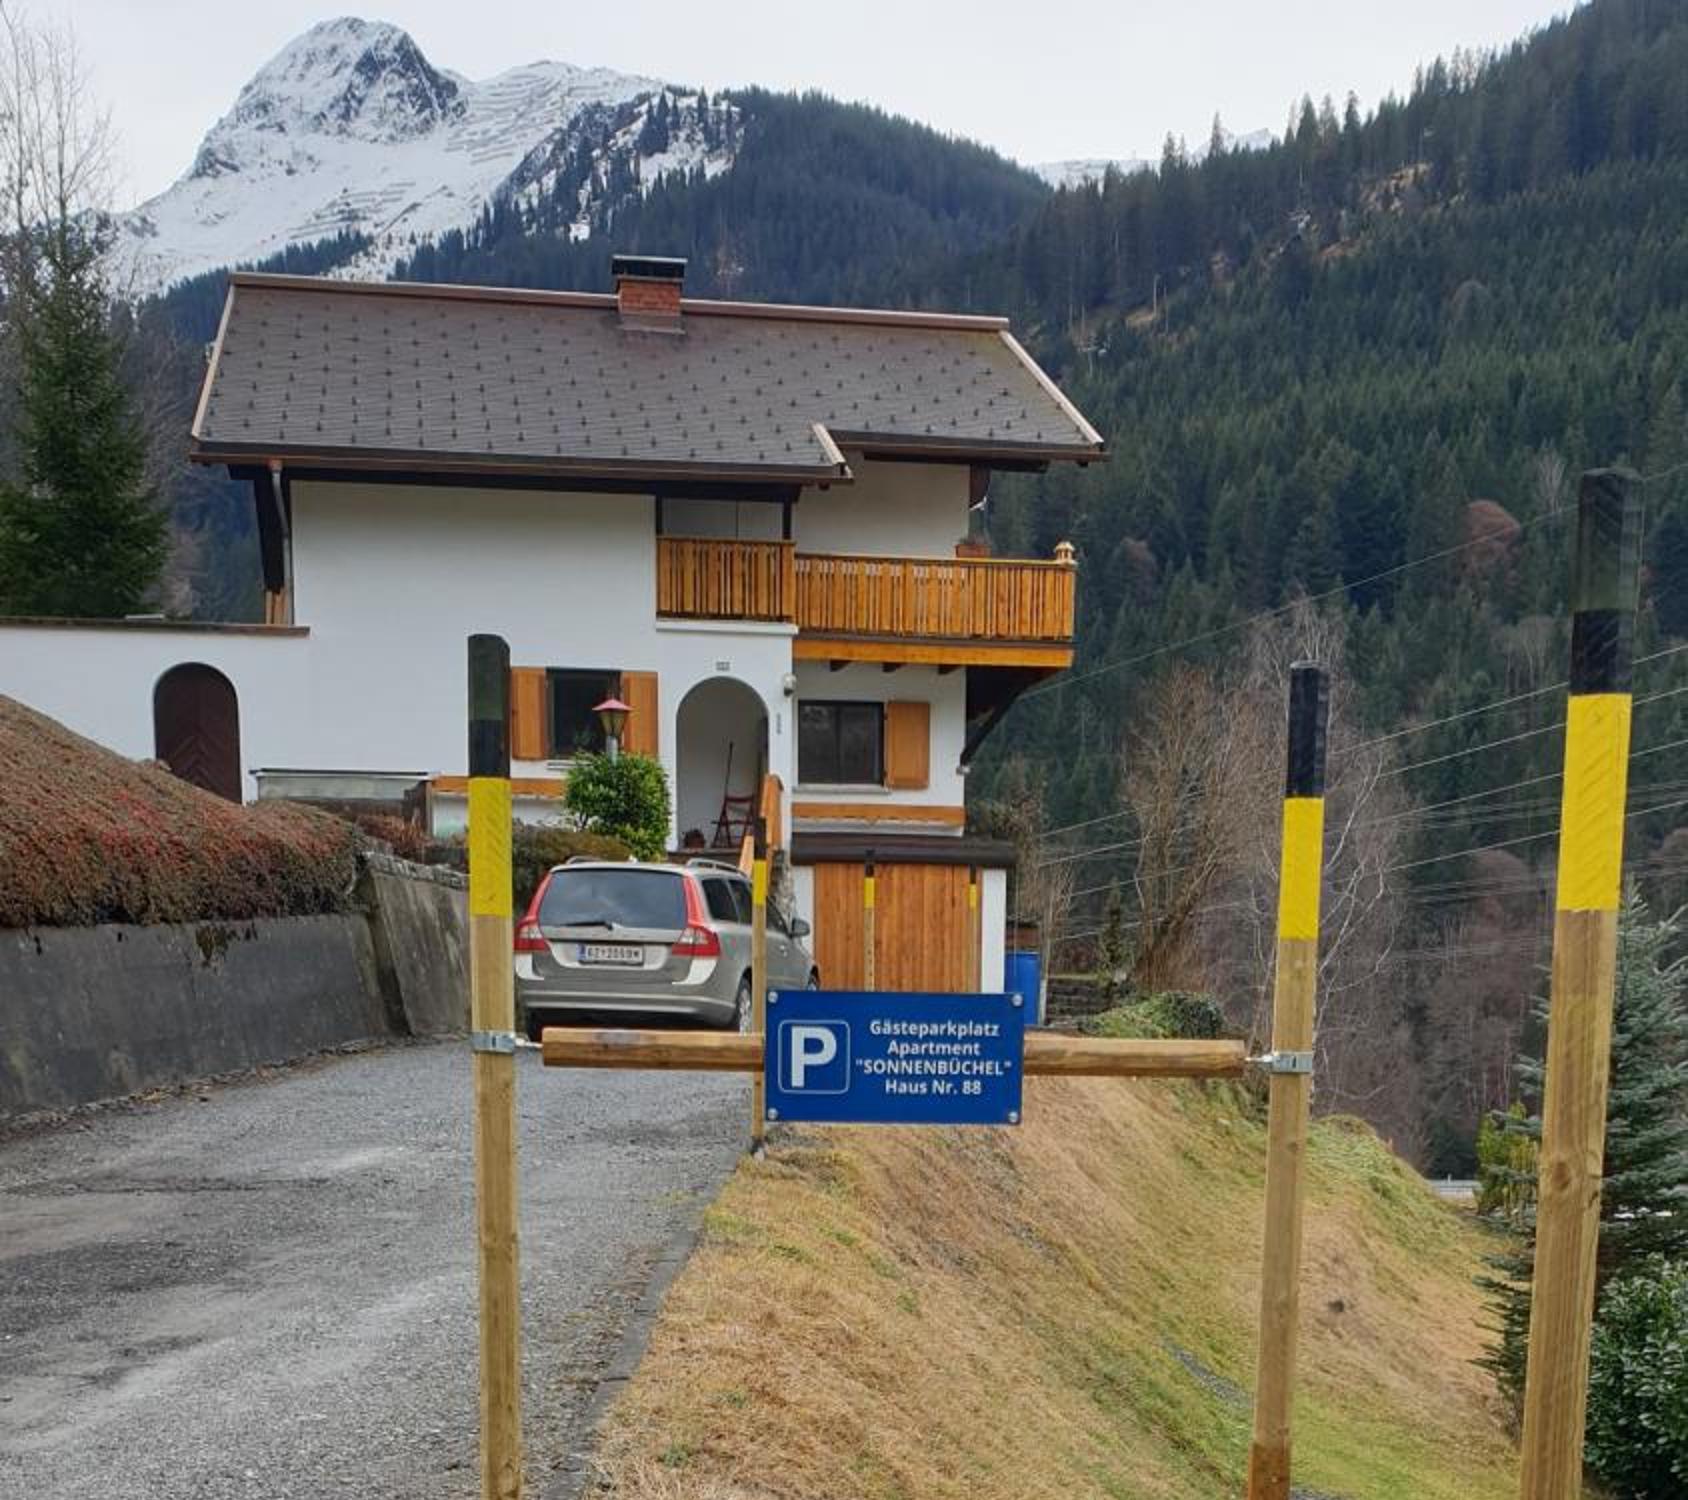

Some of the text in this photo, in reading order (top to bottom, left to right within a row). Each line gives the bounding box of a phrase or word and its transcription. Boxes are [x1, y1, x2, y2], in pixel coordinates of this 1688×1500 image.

[869, 1020, 1001, 1039] Gästeparkplatz
[790, 1025, 838, 1088] P
[887, 1040, 981, 1058] Apartment
[855, 1058, 1012, 1076] "SONNENBÜCHEL"
[884, 1080, 982, 1095] Haus Nr. 88
